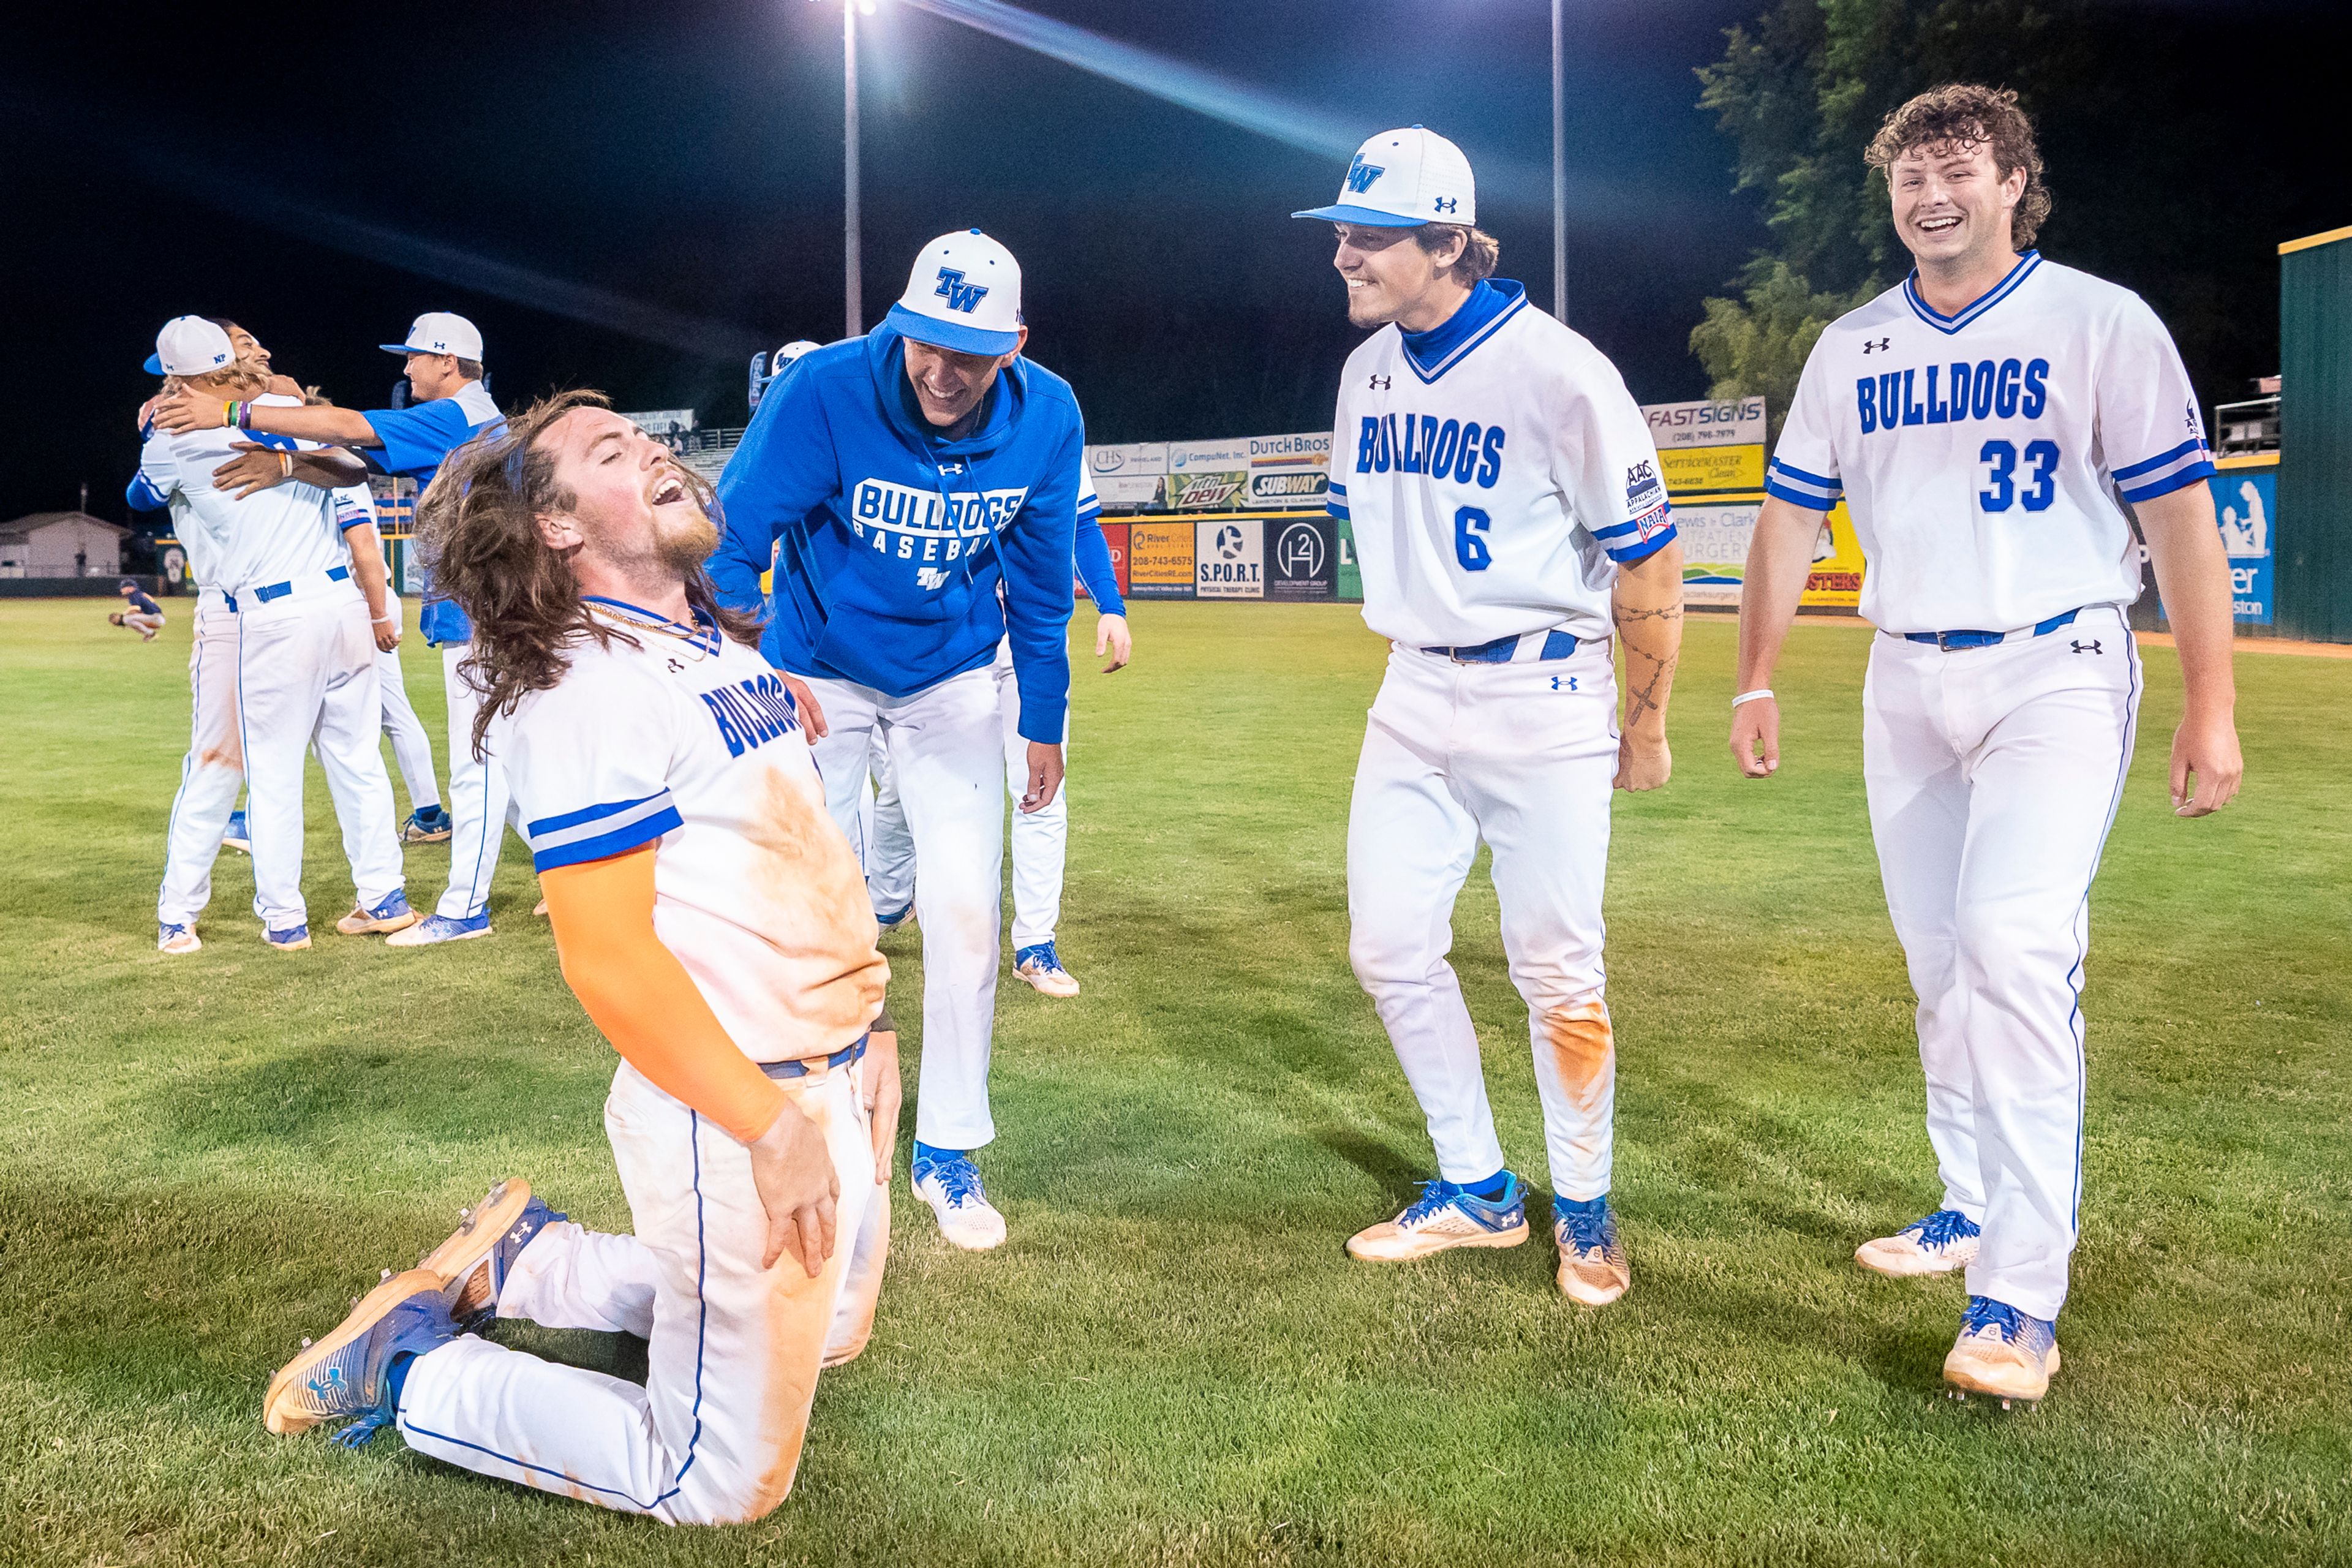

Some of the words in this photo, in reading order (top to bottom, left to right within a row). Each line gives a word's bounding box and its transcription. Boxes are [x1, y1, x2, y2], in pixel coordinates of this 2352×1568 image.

[934, 266, 989, 314] TW
[214, 354, 225, 364] NP
[1857, 358, 2049, 434] BULLDOGS
[1648, 403, 1760, 428] FASTSIGNS
[1096, 450, 1122, 464] CHS
[1356, 413, 1505, 488] BULLDOGS
[1256, 474, 1325, 496] SUBWAY
[1627, 460, 1652, 486] AAC
[1978, 439, 2060, 513] 33
[859, 484, 1022, 531] BULLDOGS
[1627, 486, 1660, 508] APPALACHIAN
[1639, 508, 1665, 535] NAIA
[1676, 517, 1706, 528] ewis
[1147, 533, 1170, 542] River
[1454, 504, 1492, 573] 6
[1200, 563, 1260, 582] S.P.O.R.T.
[1804, 573, 1861, 592] STERS
